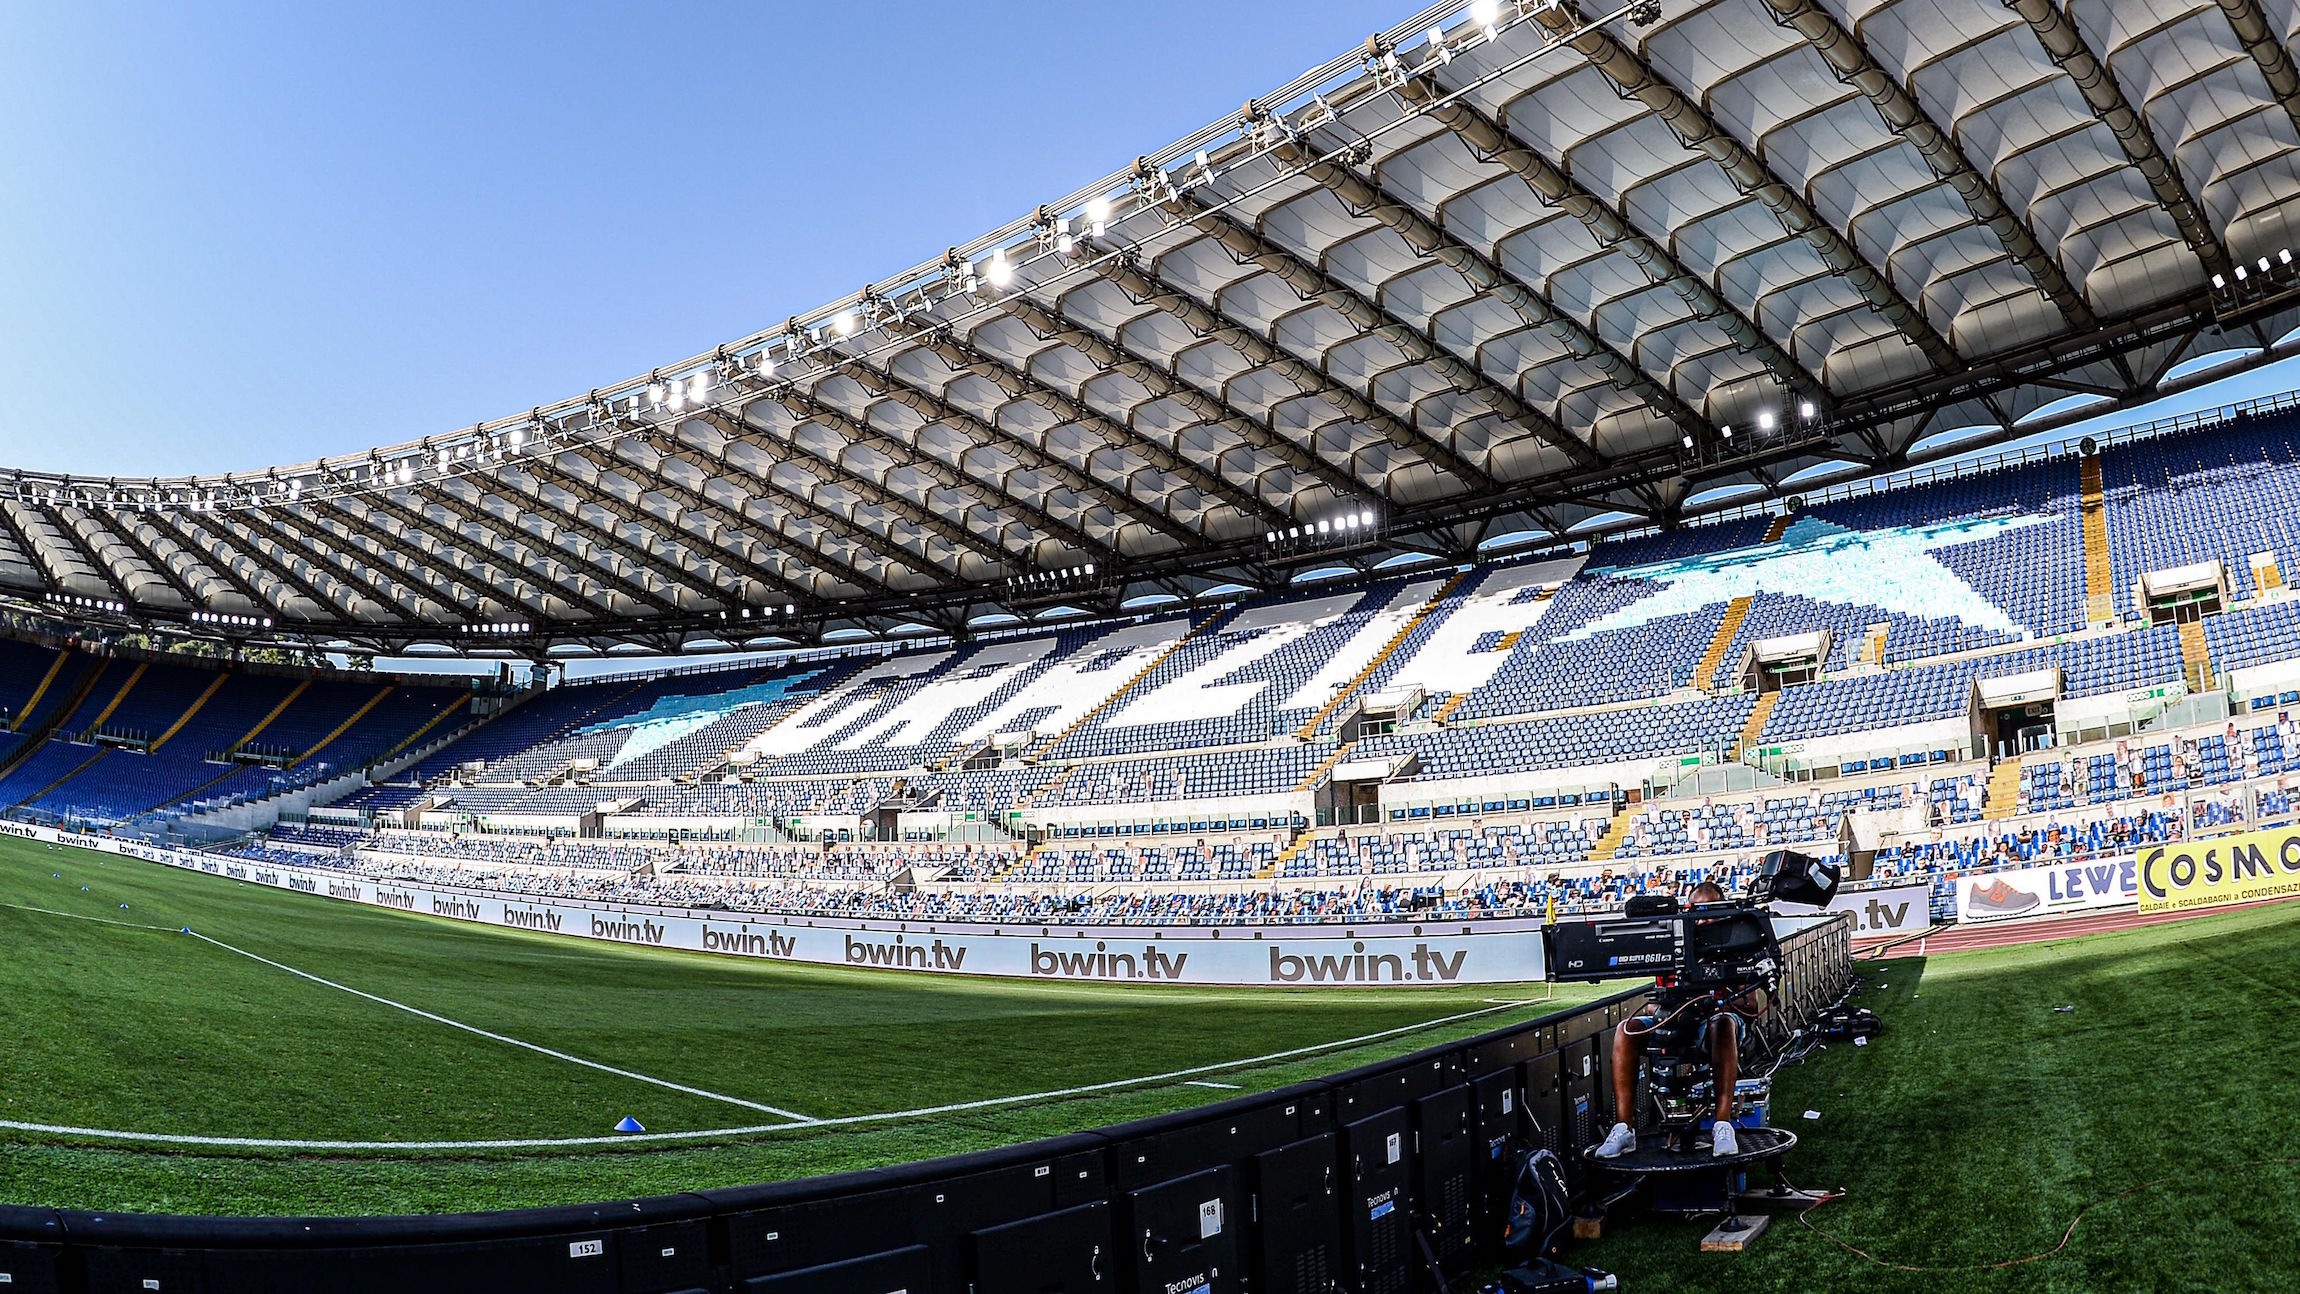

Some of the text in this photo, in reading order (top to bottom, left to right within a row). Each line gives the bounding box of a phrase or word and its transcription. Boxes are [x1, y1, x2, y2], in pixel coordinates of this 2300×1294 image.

[0, 824, 37, 838] win.tv
[57, 833, 99, 848] bwin.tv
[226, 864, 247, 879] bwin.tv
[256, 869, 279, 885] bwin.tv
[289, 874, 316, 892] bwin.tv
[328, 880, 361, 900] bwin.tv
[376, 887, 414, 909] bwin.tv
[433, 895, 480, 919] bwin.tv
[2140, 902, 2170, 912] CALDAIE
[2178, 893, 2233, 908] SCALDABAGNI
[504, 903, 562, 931] bwin.tv
[591, 913, 665, 943] bwin.tv
[702, 924, 797, 957] bwin.tv
[845, 934, 967, 971] bwin.tv
[1030, 940, 1188, 980] bwin.tv
[1269, 940, 1467, 983] bwin.tv
[1568, 960, 1583, 968] HD
[1202, 1205, 1216, 1217] 168
[578, 1243, 596, 1255] 152
